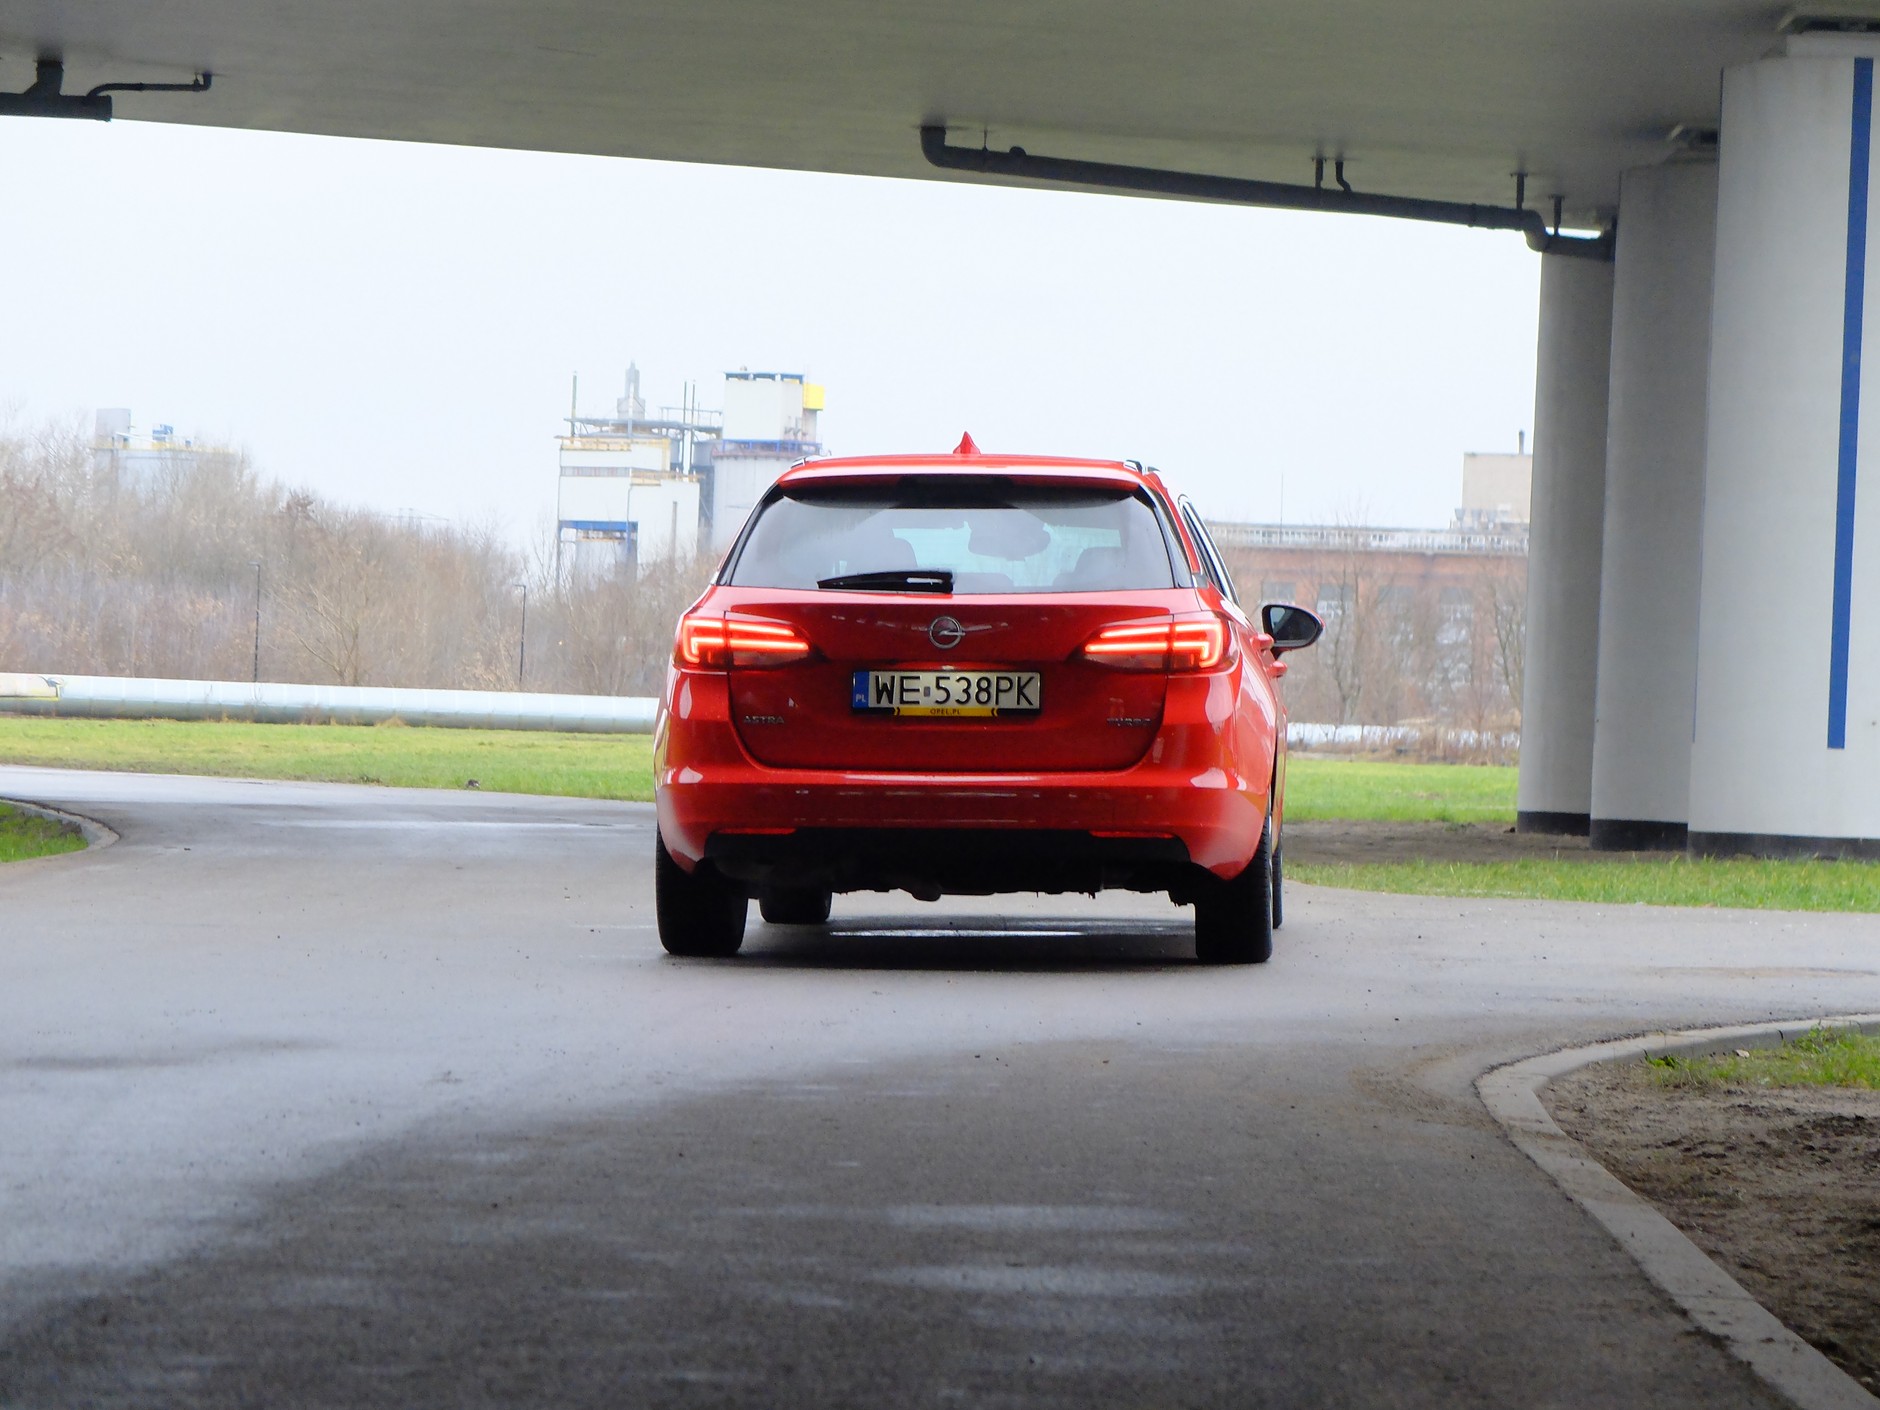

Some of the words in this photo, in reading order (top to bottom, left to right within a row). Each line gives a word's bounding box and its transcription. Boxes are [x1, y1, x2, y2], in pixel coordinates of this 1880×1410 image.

[855, 693, 867, 703] PL
[875, 675, 921, 705] WE
[934, 676, 1034, 706] 538PK
